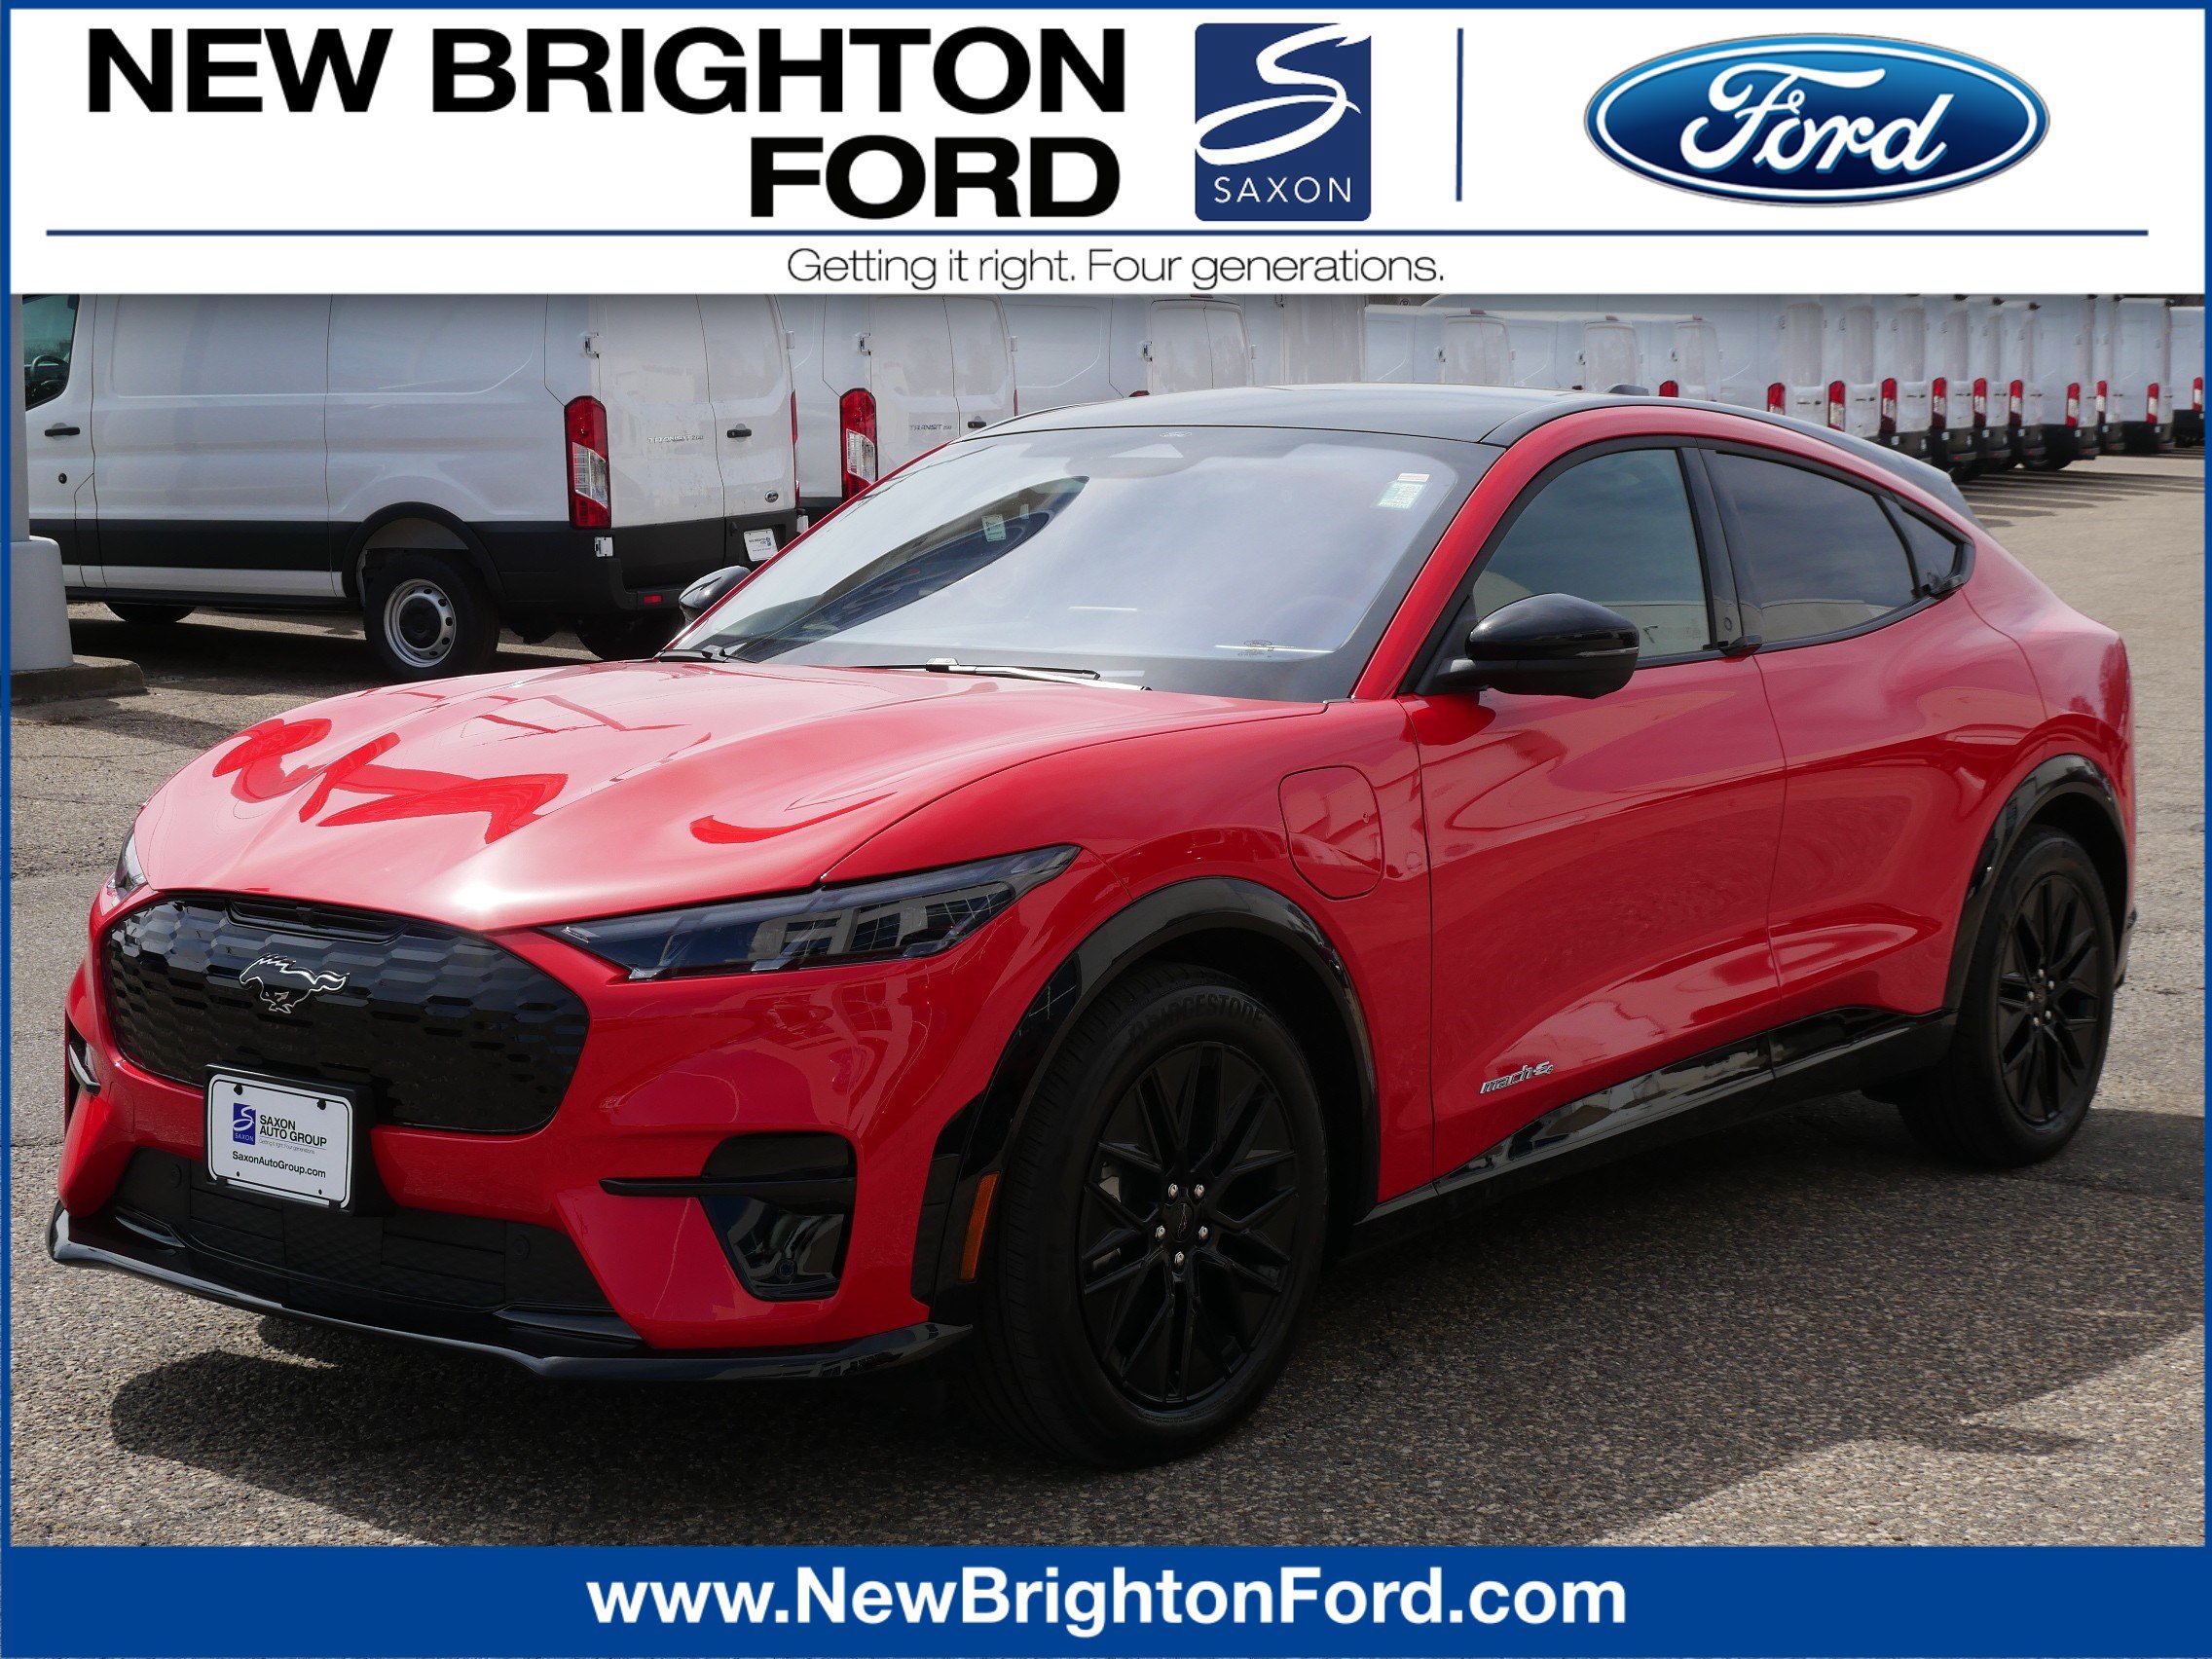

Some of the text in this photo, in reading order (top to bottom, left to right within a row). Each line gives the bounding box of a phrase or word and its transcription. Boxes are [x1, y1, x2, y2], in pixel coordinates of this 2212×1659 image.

[260, 1114, 296, 1131] SAXON
[235, 1132, 254, 1142] SAXON
[259, 1125, 327, 1147] AUTO GROUP
[232, 1151, 326, 1178] SaxonAutoGroup.com
